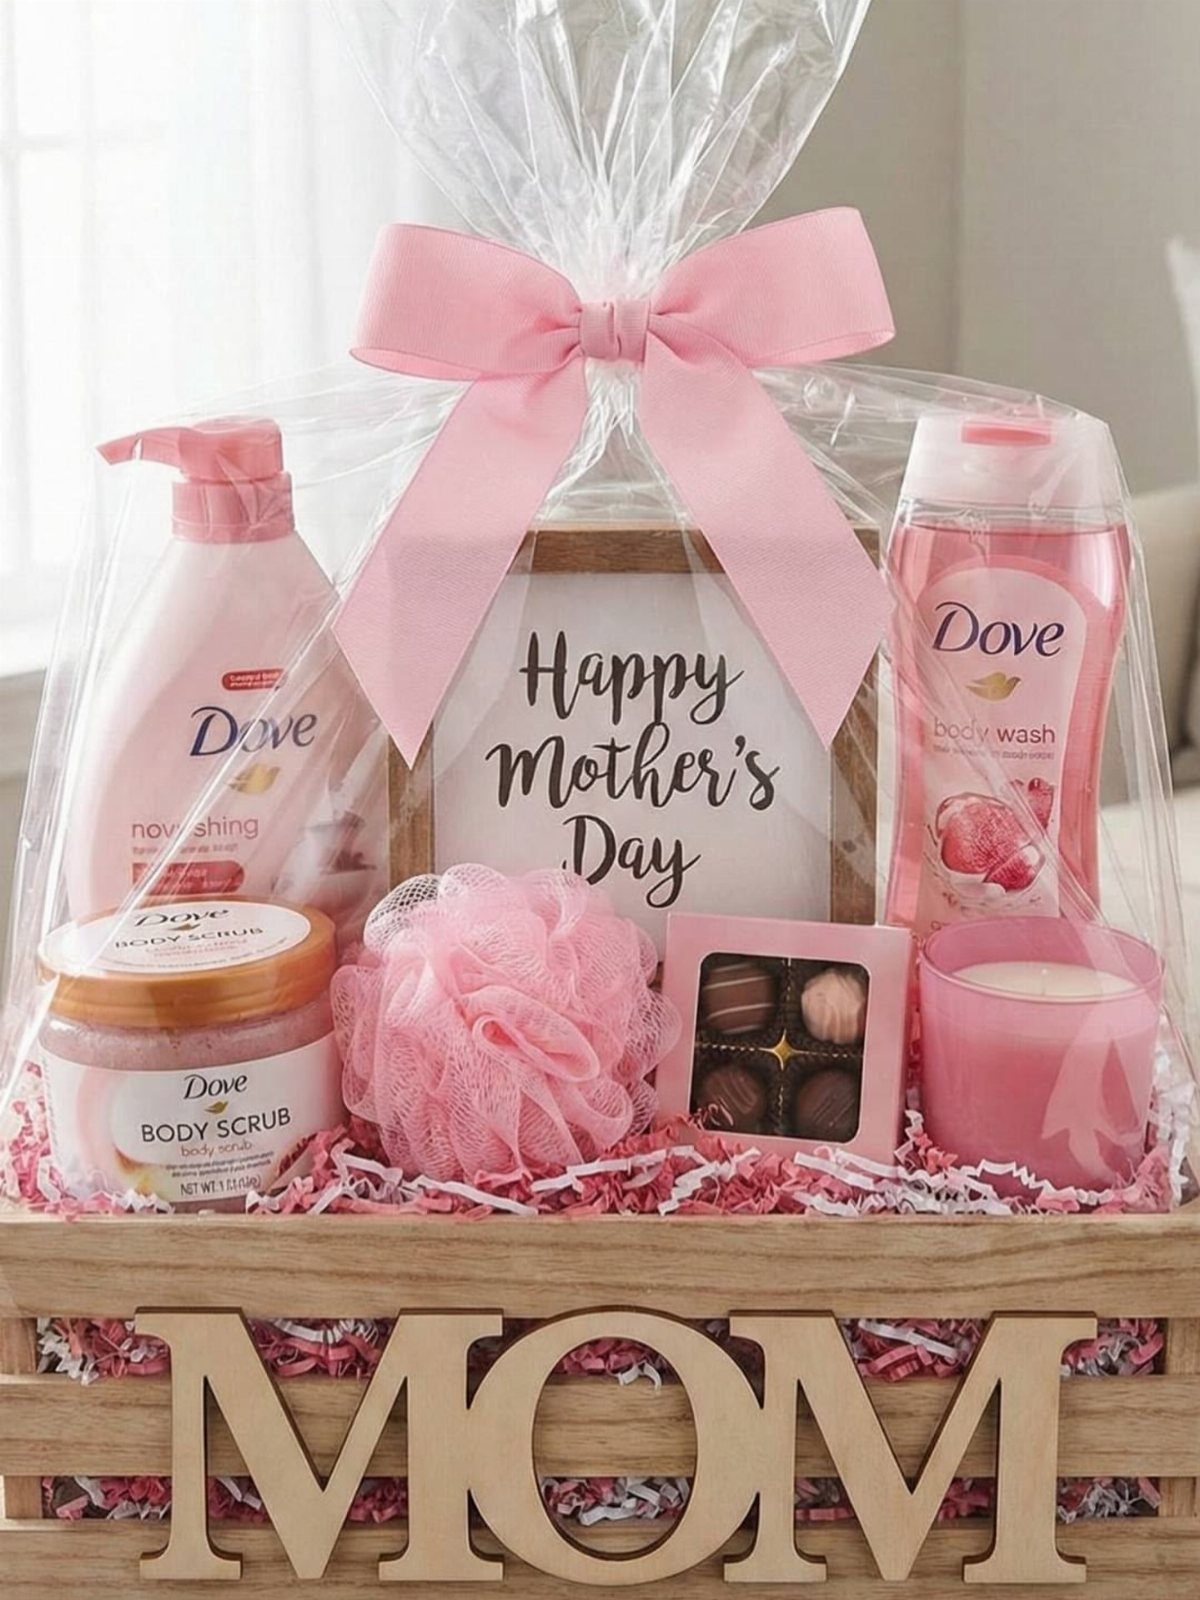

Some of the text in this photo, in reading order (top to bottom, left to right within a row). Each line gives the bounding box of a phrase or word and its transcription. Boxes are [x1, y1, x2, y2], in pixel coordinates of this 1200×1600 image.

[932, 601, 1065, 657] Dove
[519, 630, 745, 725] Happy
[189, 705, 317, 757] Dove
[996, 723, 1056, 744] wash
[485, 721, 780, 811] Mother's
[561, 814, 702, 908] Day
[115, 935, 181, 949] BODY
[188, 927, 264, 942] SCRUB
[134, 909, 229, 927] Dove
[183, 1073, 248, 1100] Dove
[140, 1107, 291, 1143] BODY SCRUB
[180, 1143, 215, 1158] body
[135, 1306, 1098, 1586] MOM
